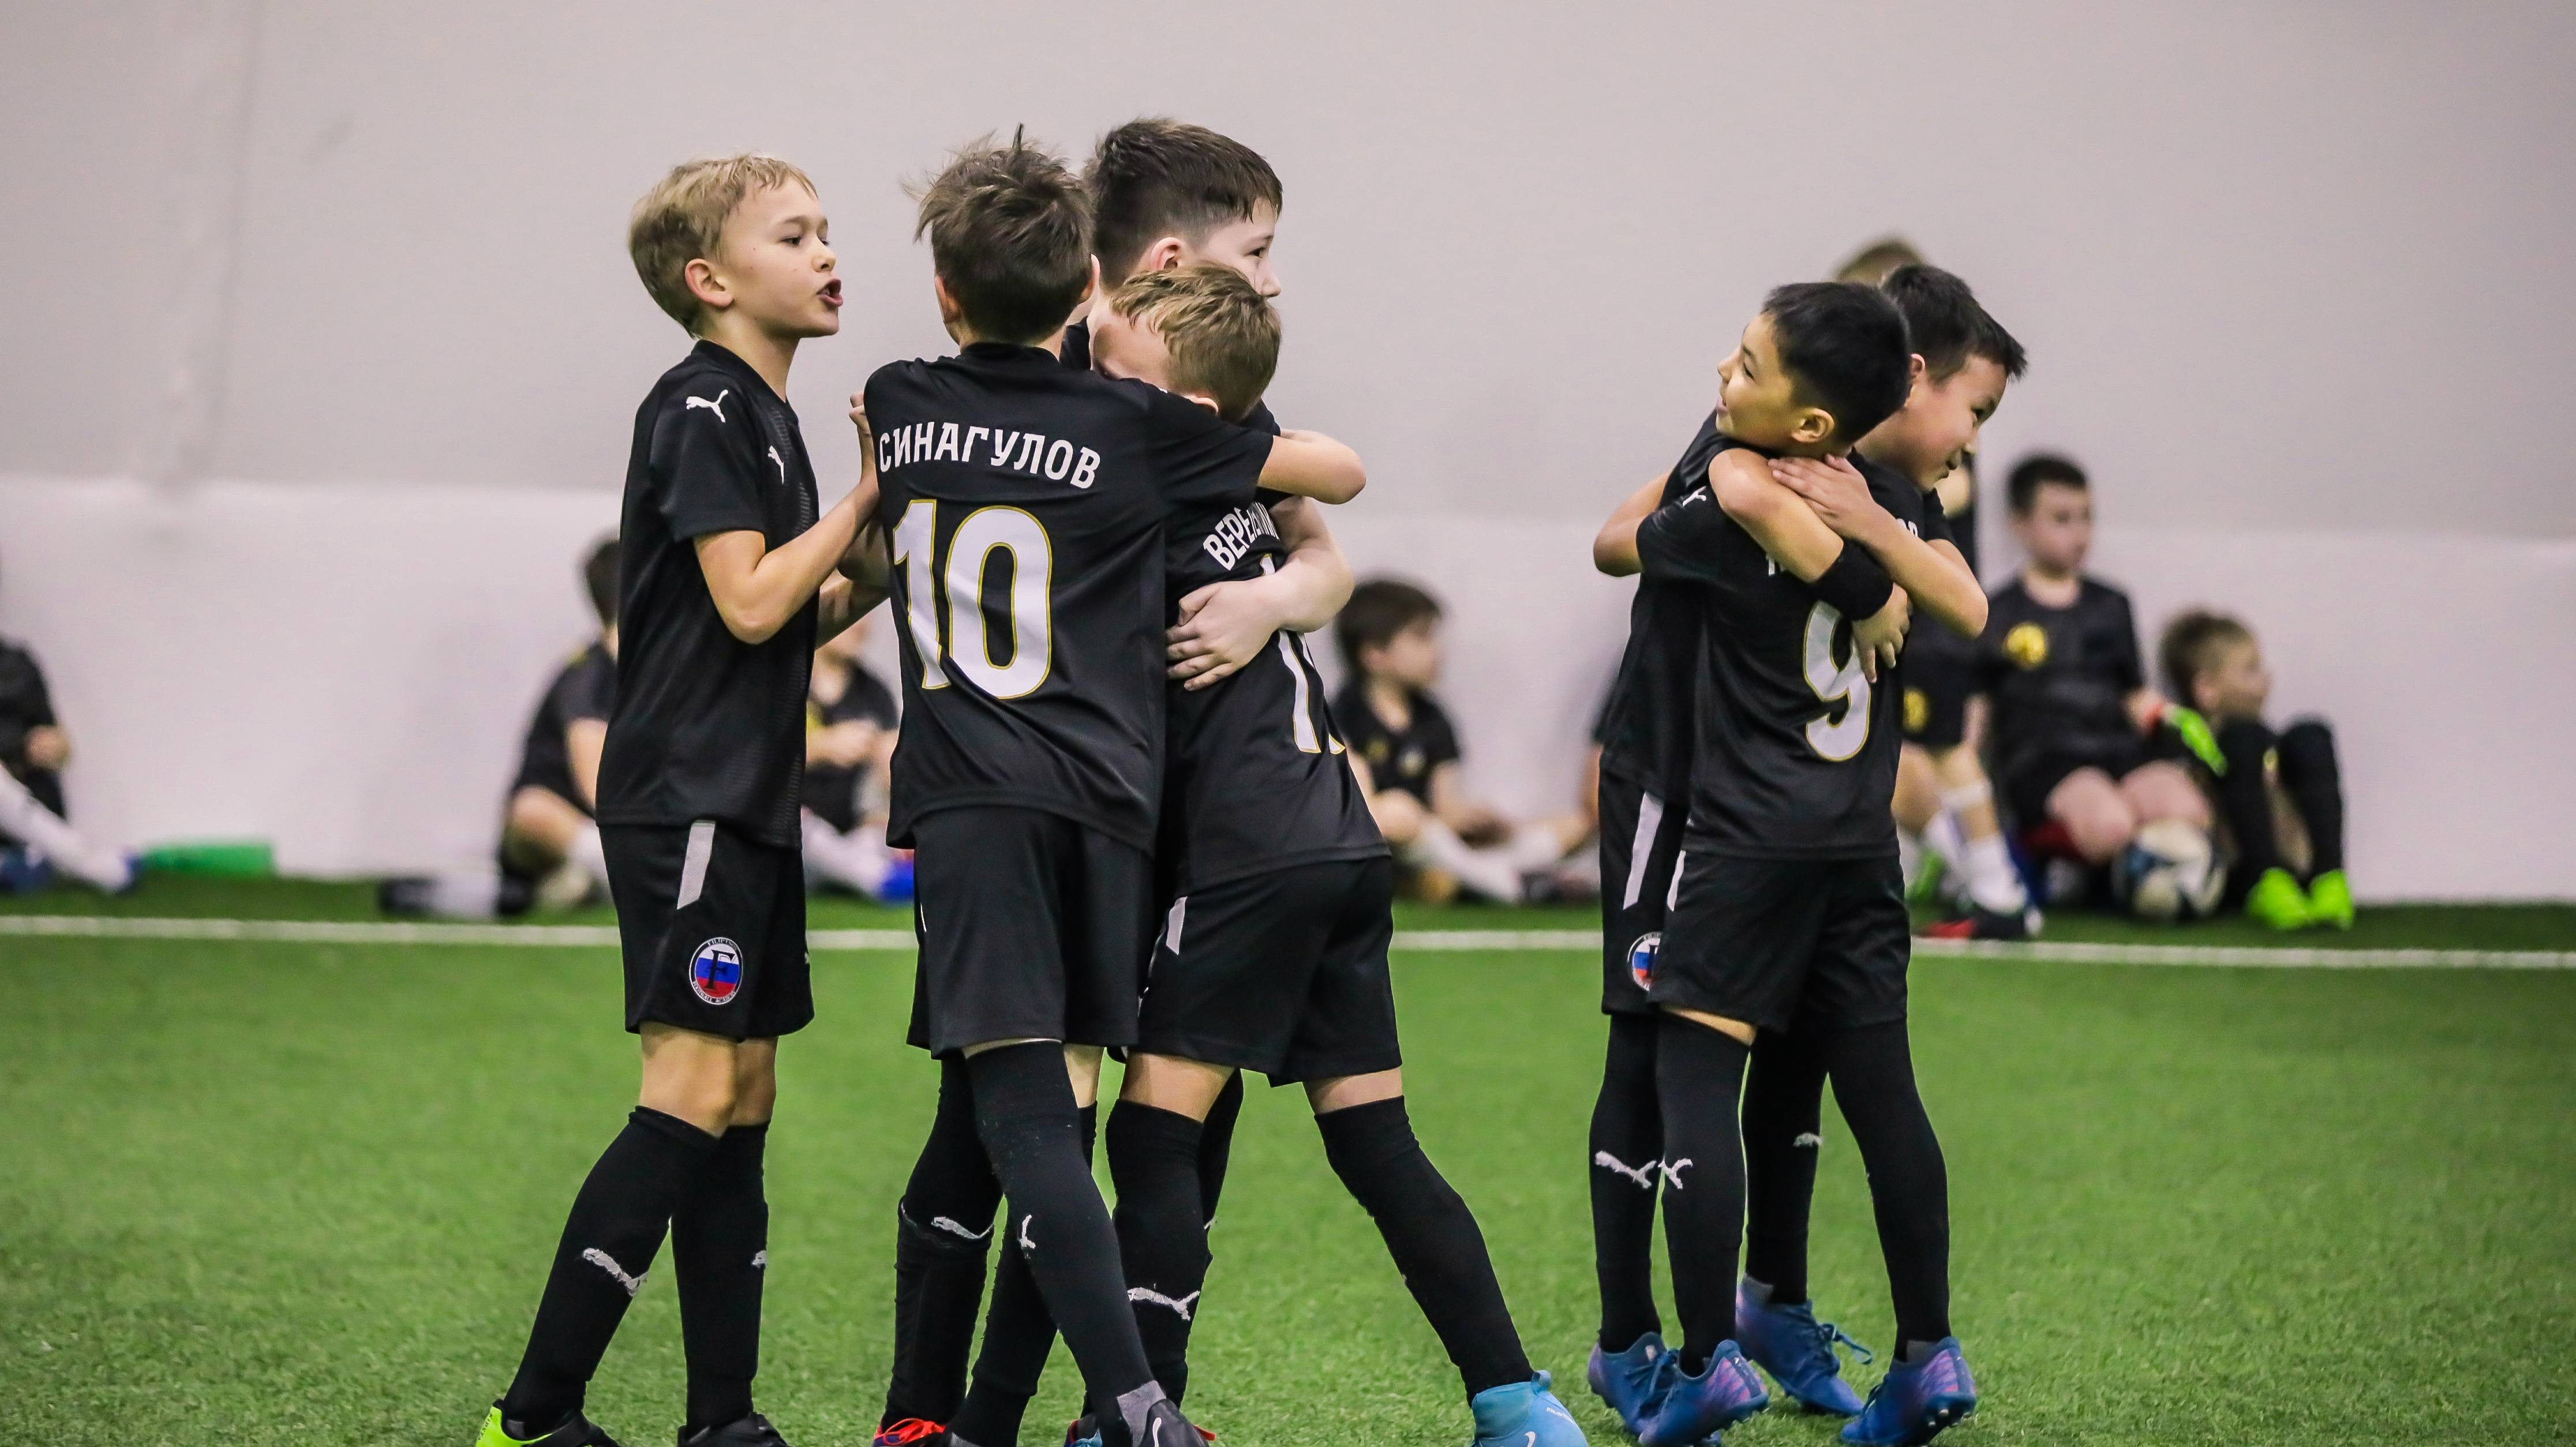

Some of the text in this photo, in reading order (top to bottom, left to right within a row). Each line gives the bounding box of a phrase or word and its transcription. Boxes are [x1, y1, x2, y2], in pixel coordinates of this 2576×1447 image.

[879, 422, 1100, 489] СИНАГУЛОВ
[893, 499, 1053, 700] 10
[1803, 599, 1871, 762] 9
